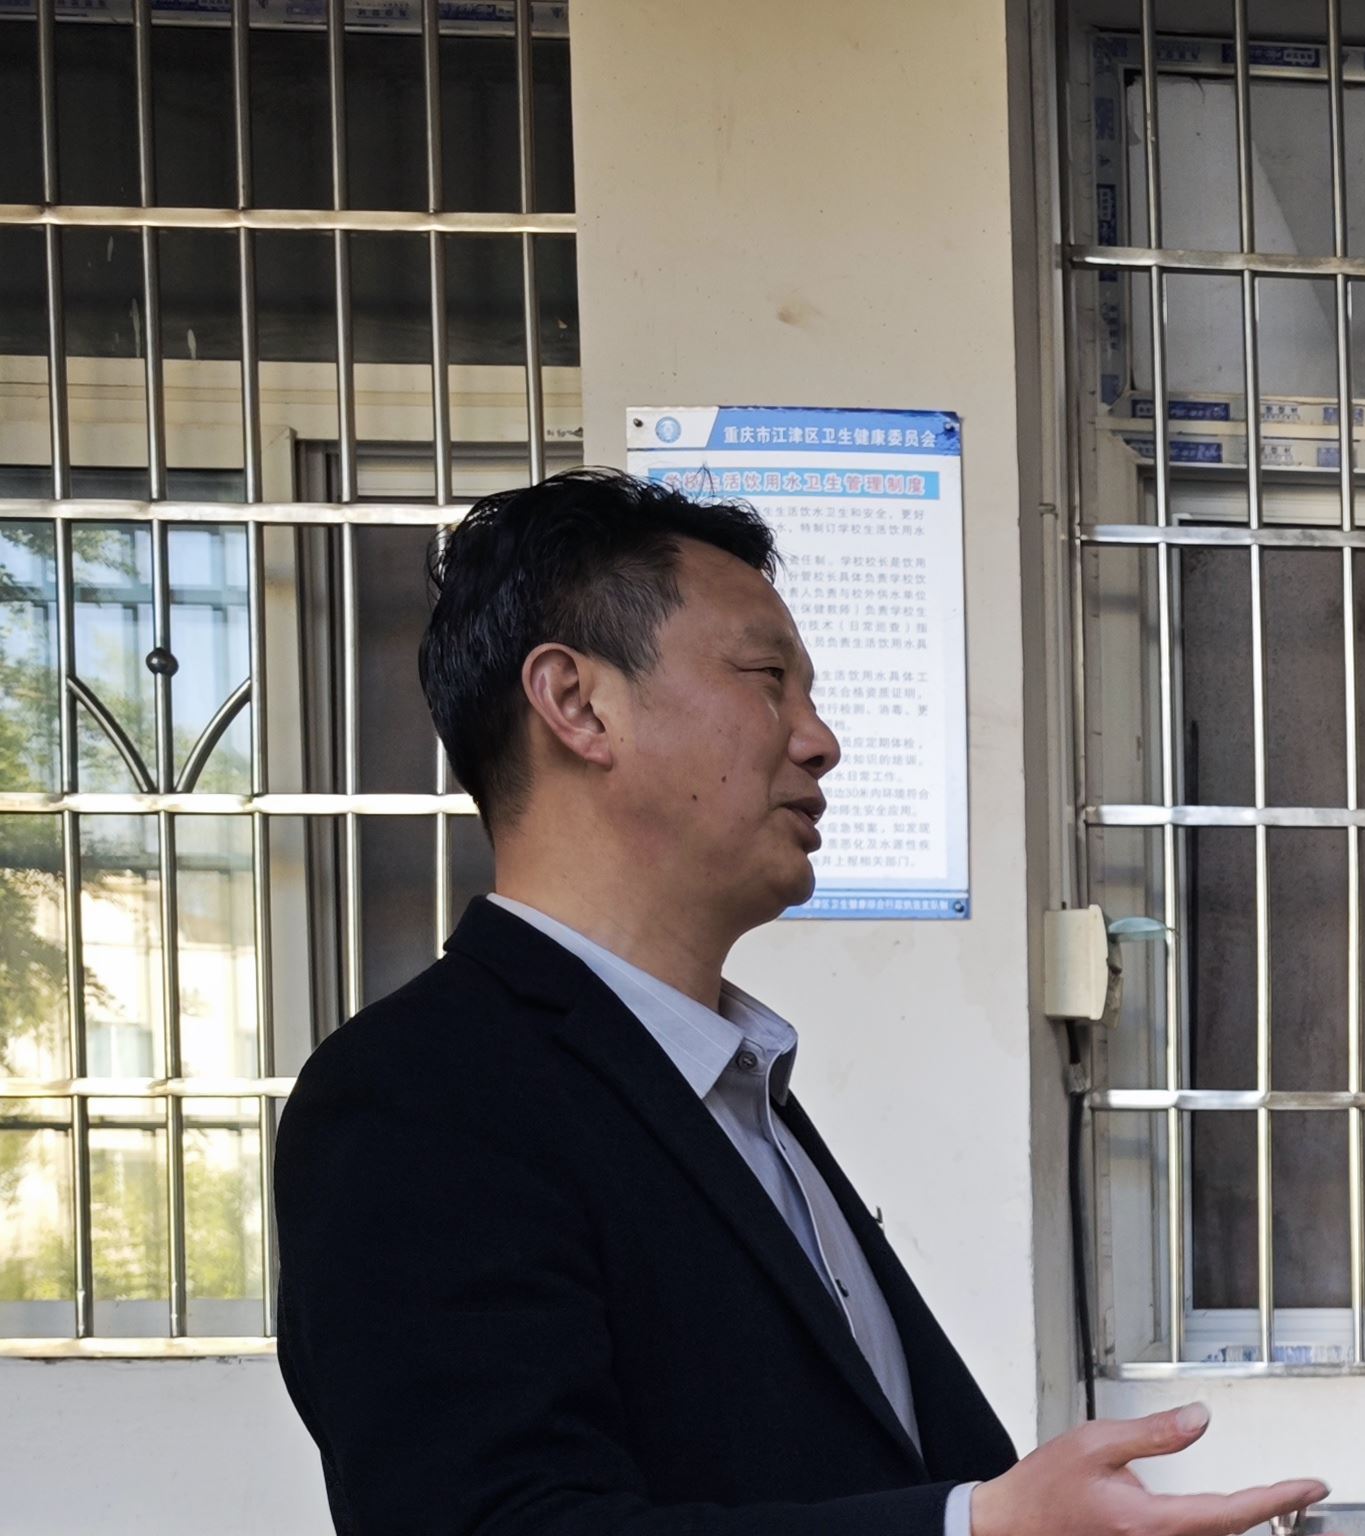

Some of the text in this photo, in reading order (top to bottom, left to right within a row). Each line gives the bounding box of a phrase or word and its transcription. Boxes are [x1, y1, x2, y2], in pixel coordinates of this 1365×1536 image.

[723, 426, 937, 448] 重庆市江津区卫生健康委员会
[815, 670, 929, 683] 生活饮用水具体工
